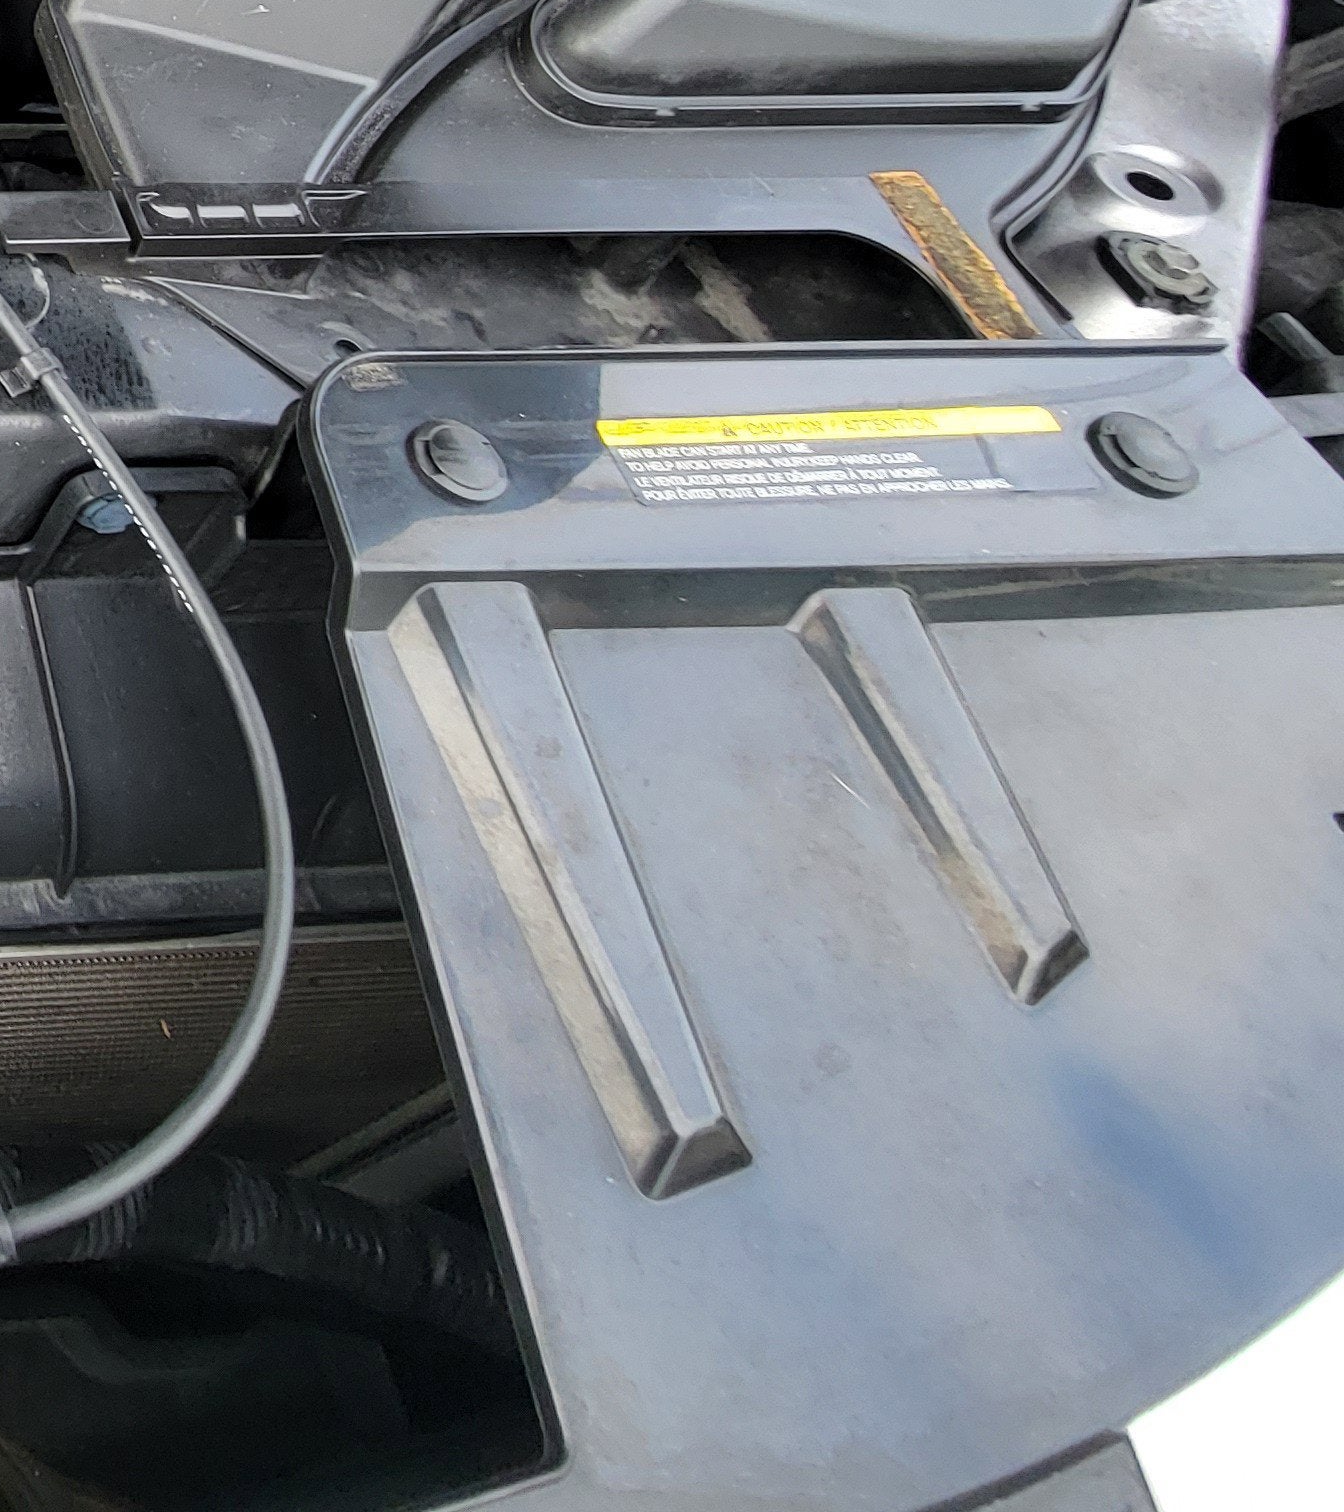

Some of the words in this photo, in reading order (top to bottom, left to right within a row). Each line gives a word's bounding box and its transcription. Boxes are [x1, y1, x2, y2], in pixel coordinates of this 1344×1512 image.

[746, 419, 825, 436] CAUTION
[844, 417, 938, 432] ATTENTION
[642, 447, 680, 459] BLADE
[680, 446, 707, 458] CAN
[706, 445, 744, 457] START
[760, 444, 783, 455] ANY
[625, 461, 643, 473] TO
[644, 460, 675, 472] HELP
[675, 459, 710, 471] AVOID
[711, 457, 773, 470] PERSONAL
[840, 453, 881, 465] HANDS
[650, 473, 724, 487] VENTILATEUR
[724, 472, 769, 485] RISQUE
[859, 468, 890, 480] TOUT
[642, 490, 681, 502] POUR
[719, 487, 758, 500] TOUTE
[837, 482, 862, 495] PAS
[876, 480, 950, 493] APPROCHER
